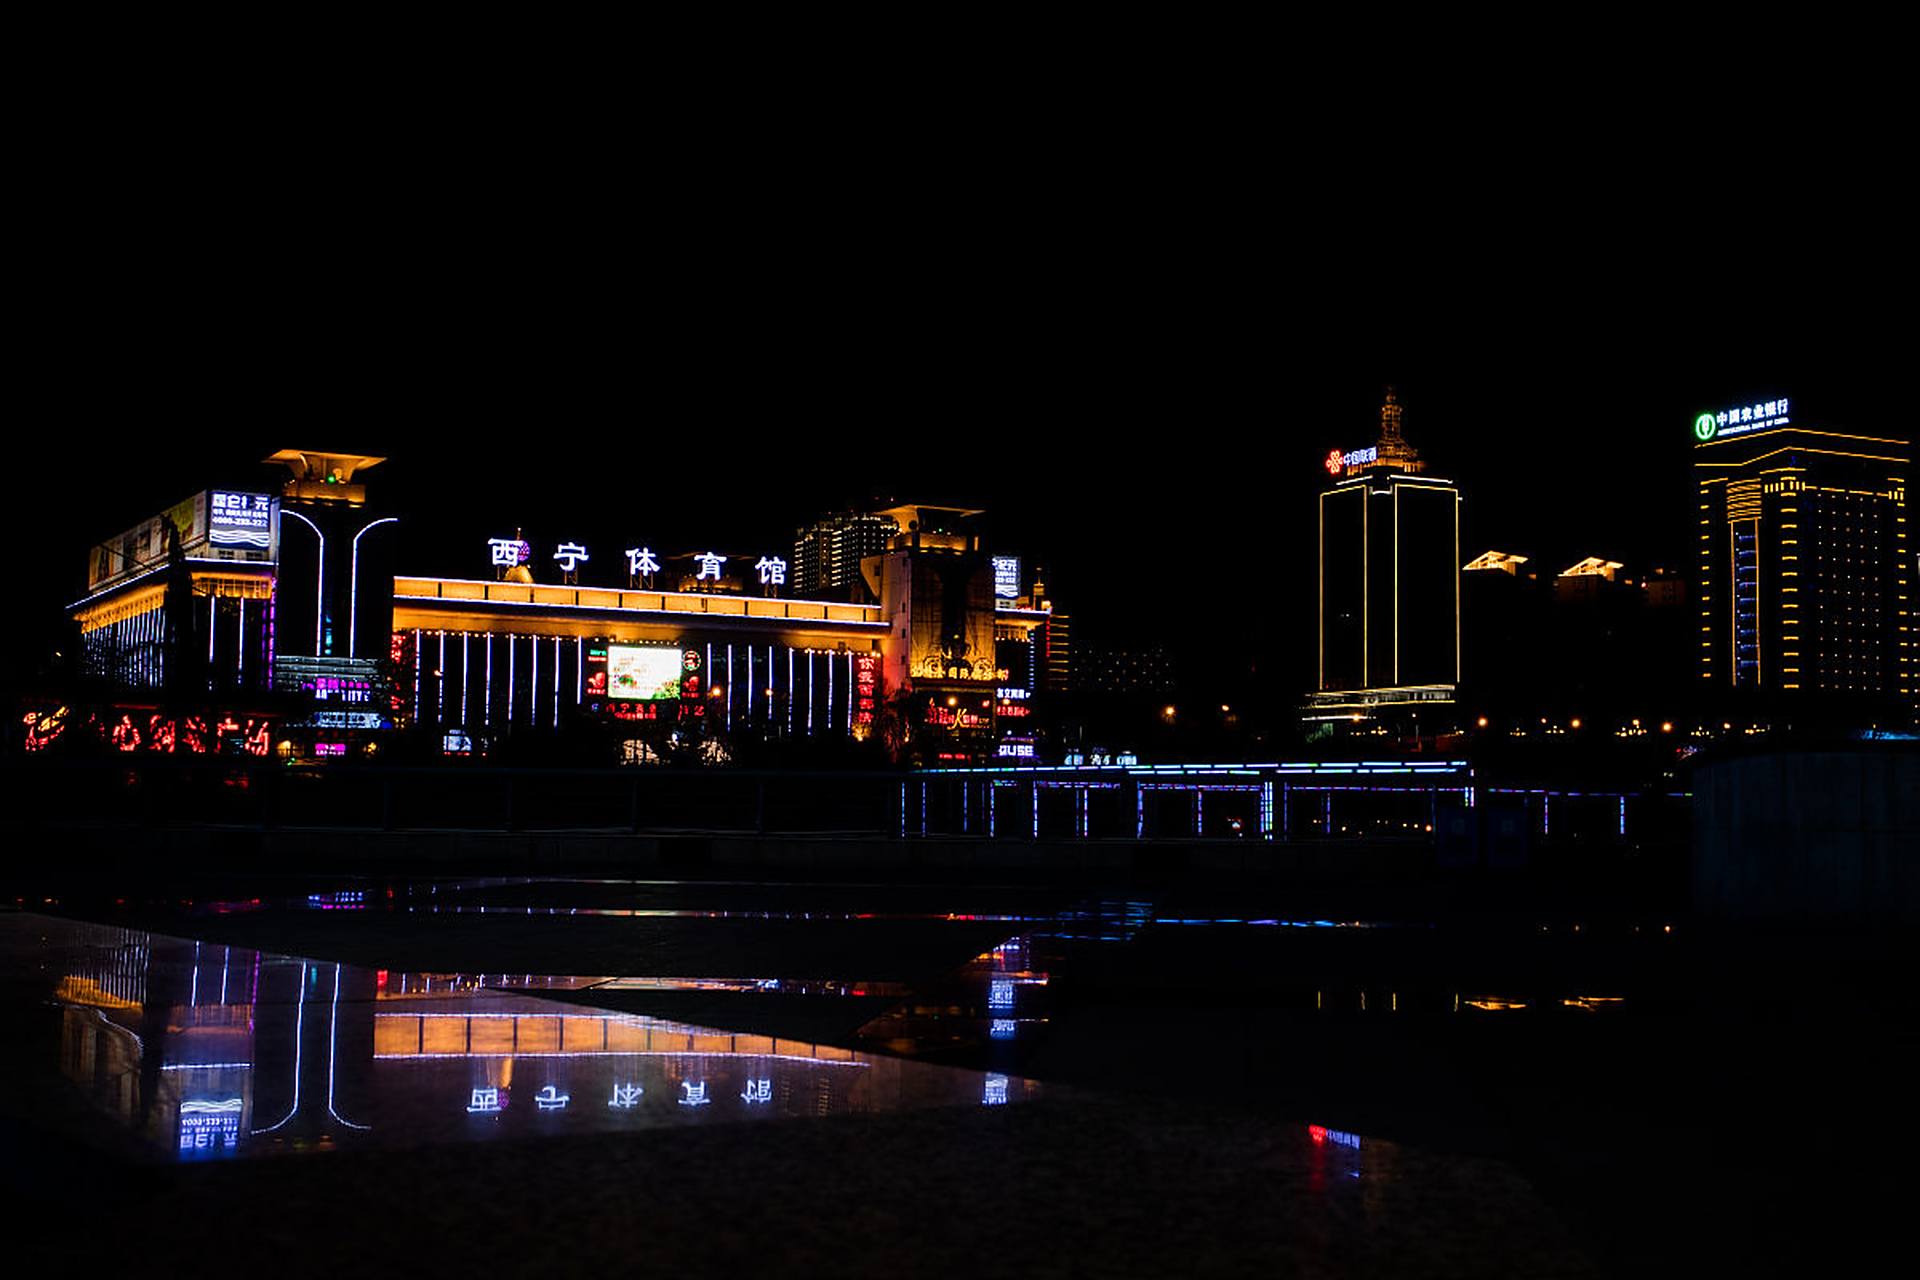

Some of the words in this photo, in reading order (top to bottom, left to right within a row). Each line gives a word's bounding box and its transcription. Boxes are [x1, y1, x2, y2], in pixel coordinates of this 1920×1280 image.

[1716, 398, 1788, 427] 中国农业银行
[488, 537, 787, 586] 西宁体育馆
